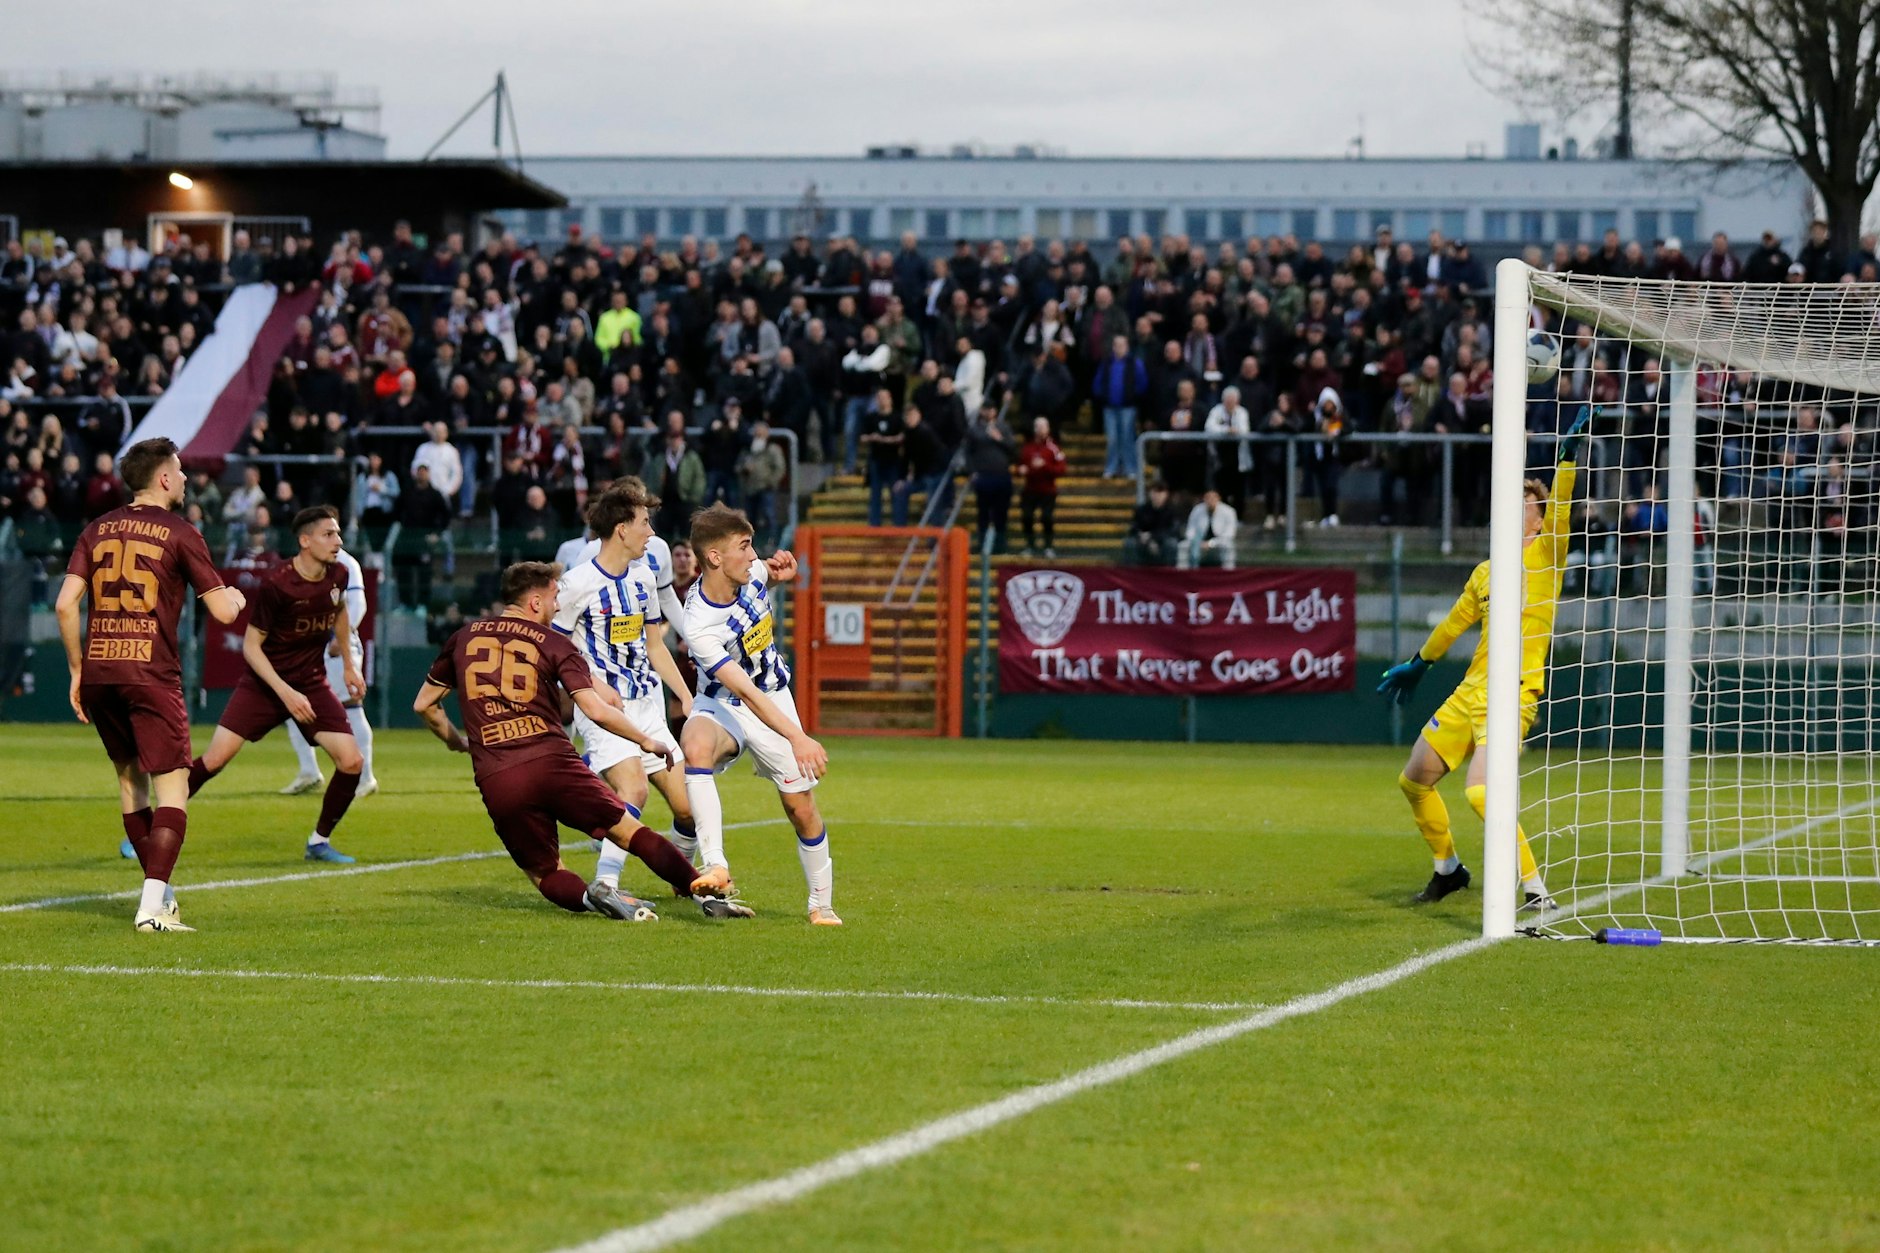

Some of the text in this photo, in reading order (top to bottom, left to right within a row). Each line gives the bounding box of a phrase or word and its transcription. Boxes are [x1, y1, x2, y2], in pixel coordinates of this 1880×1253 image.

[98, 519, 170, 541] BFC DYNAMO
[92, 538, 164, 612] 25
[1091, 587, 1343, 633] There Is A Light
[91, 618, 157, 634] STOCKINGER
[470, 622, 546, 643] BFC DYNAMO
[832, 612, 859, 635] 10
[105, 640, 149, 660] BBK
[465, 637, 540, 703] 26
[1032, 648, 1345, 682] That Never Goes Out
[500, 716, 547, 740] BBK
